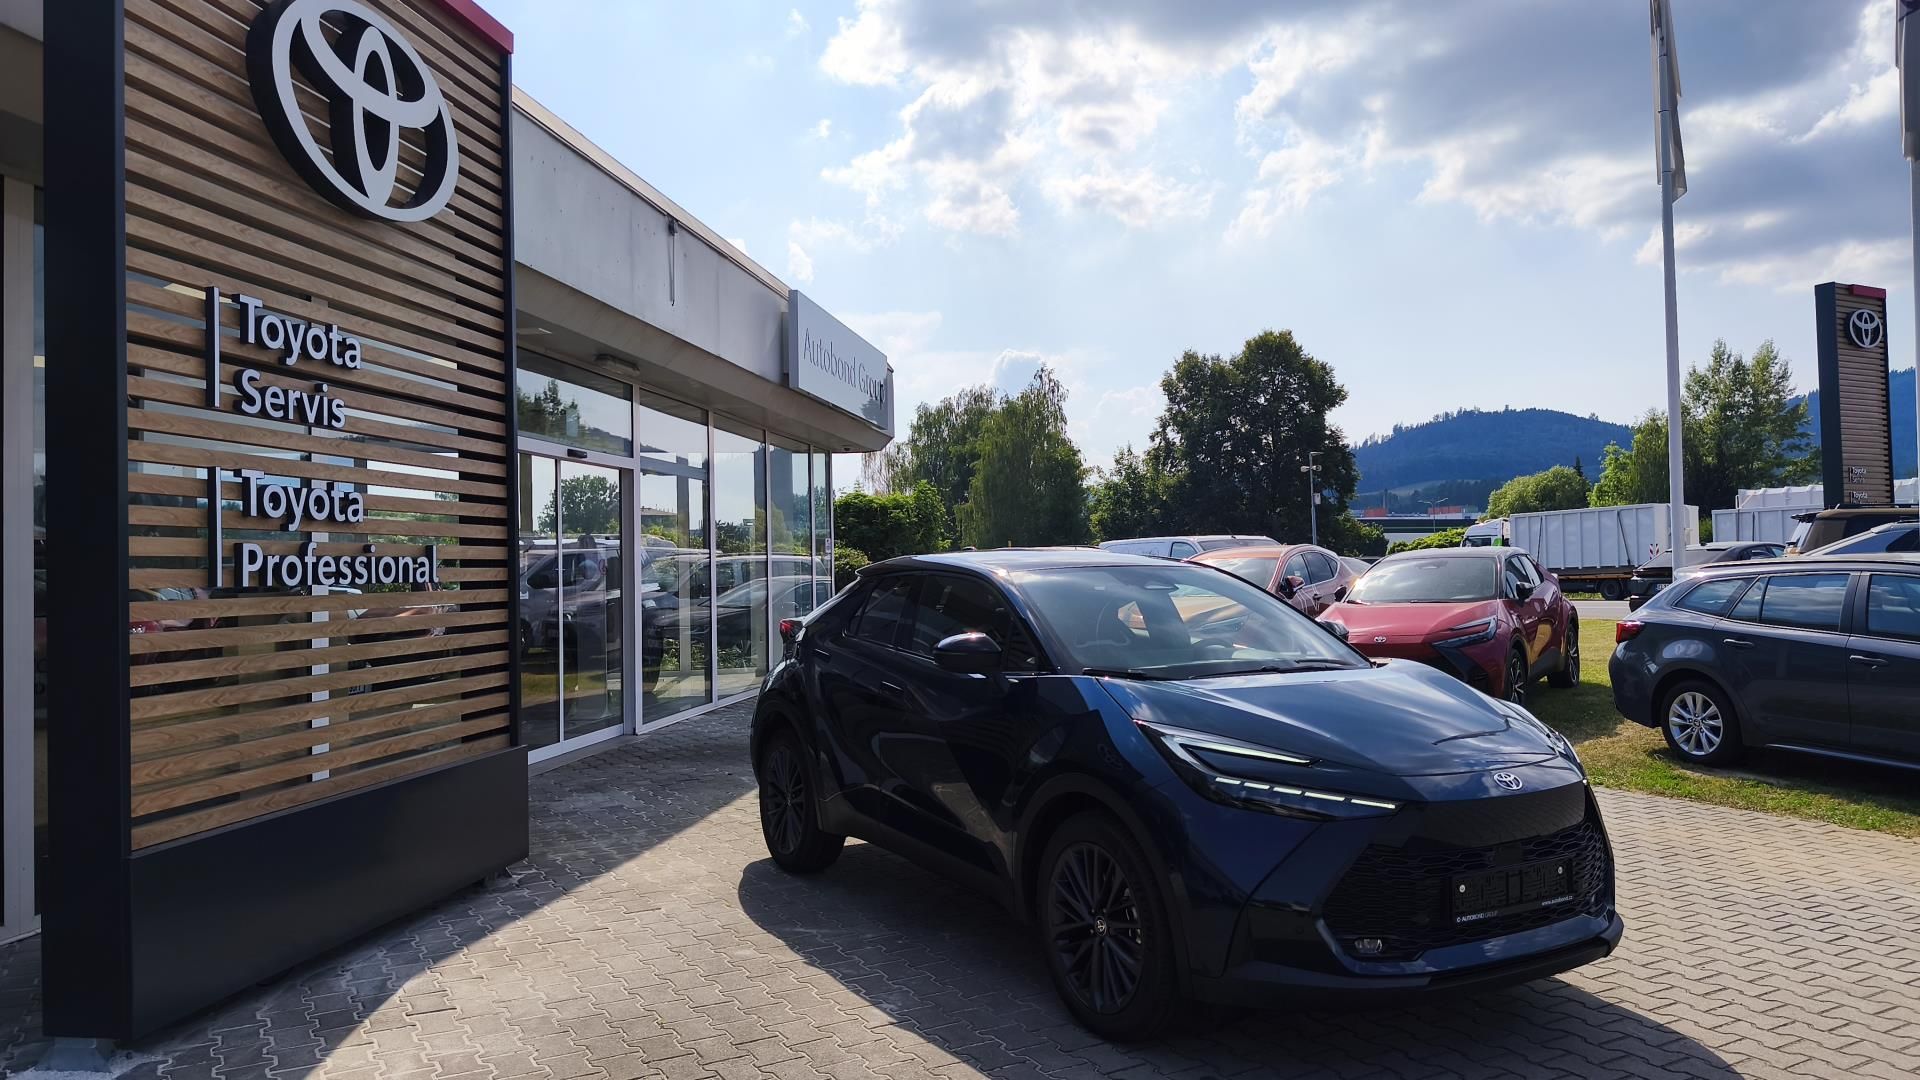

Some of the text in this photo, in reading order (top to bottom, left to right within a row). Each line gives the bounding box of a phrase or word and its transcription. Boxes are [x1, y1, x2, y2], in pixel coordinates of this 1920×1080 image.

[237, 293, 362, 370] Toyota
[803, 327, 886, 407] Autobond Group
[238, 368, 347, 429] Servis
[237, 468, 365, 532] Toyota
[1852, 466, 1867, 475] Toyota
[1853, 491, 1868, 500] Toyota
[240, 541, 440, 588] Professional
